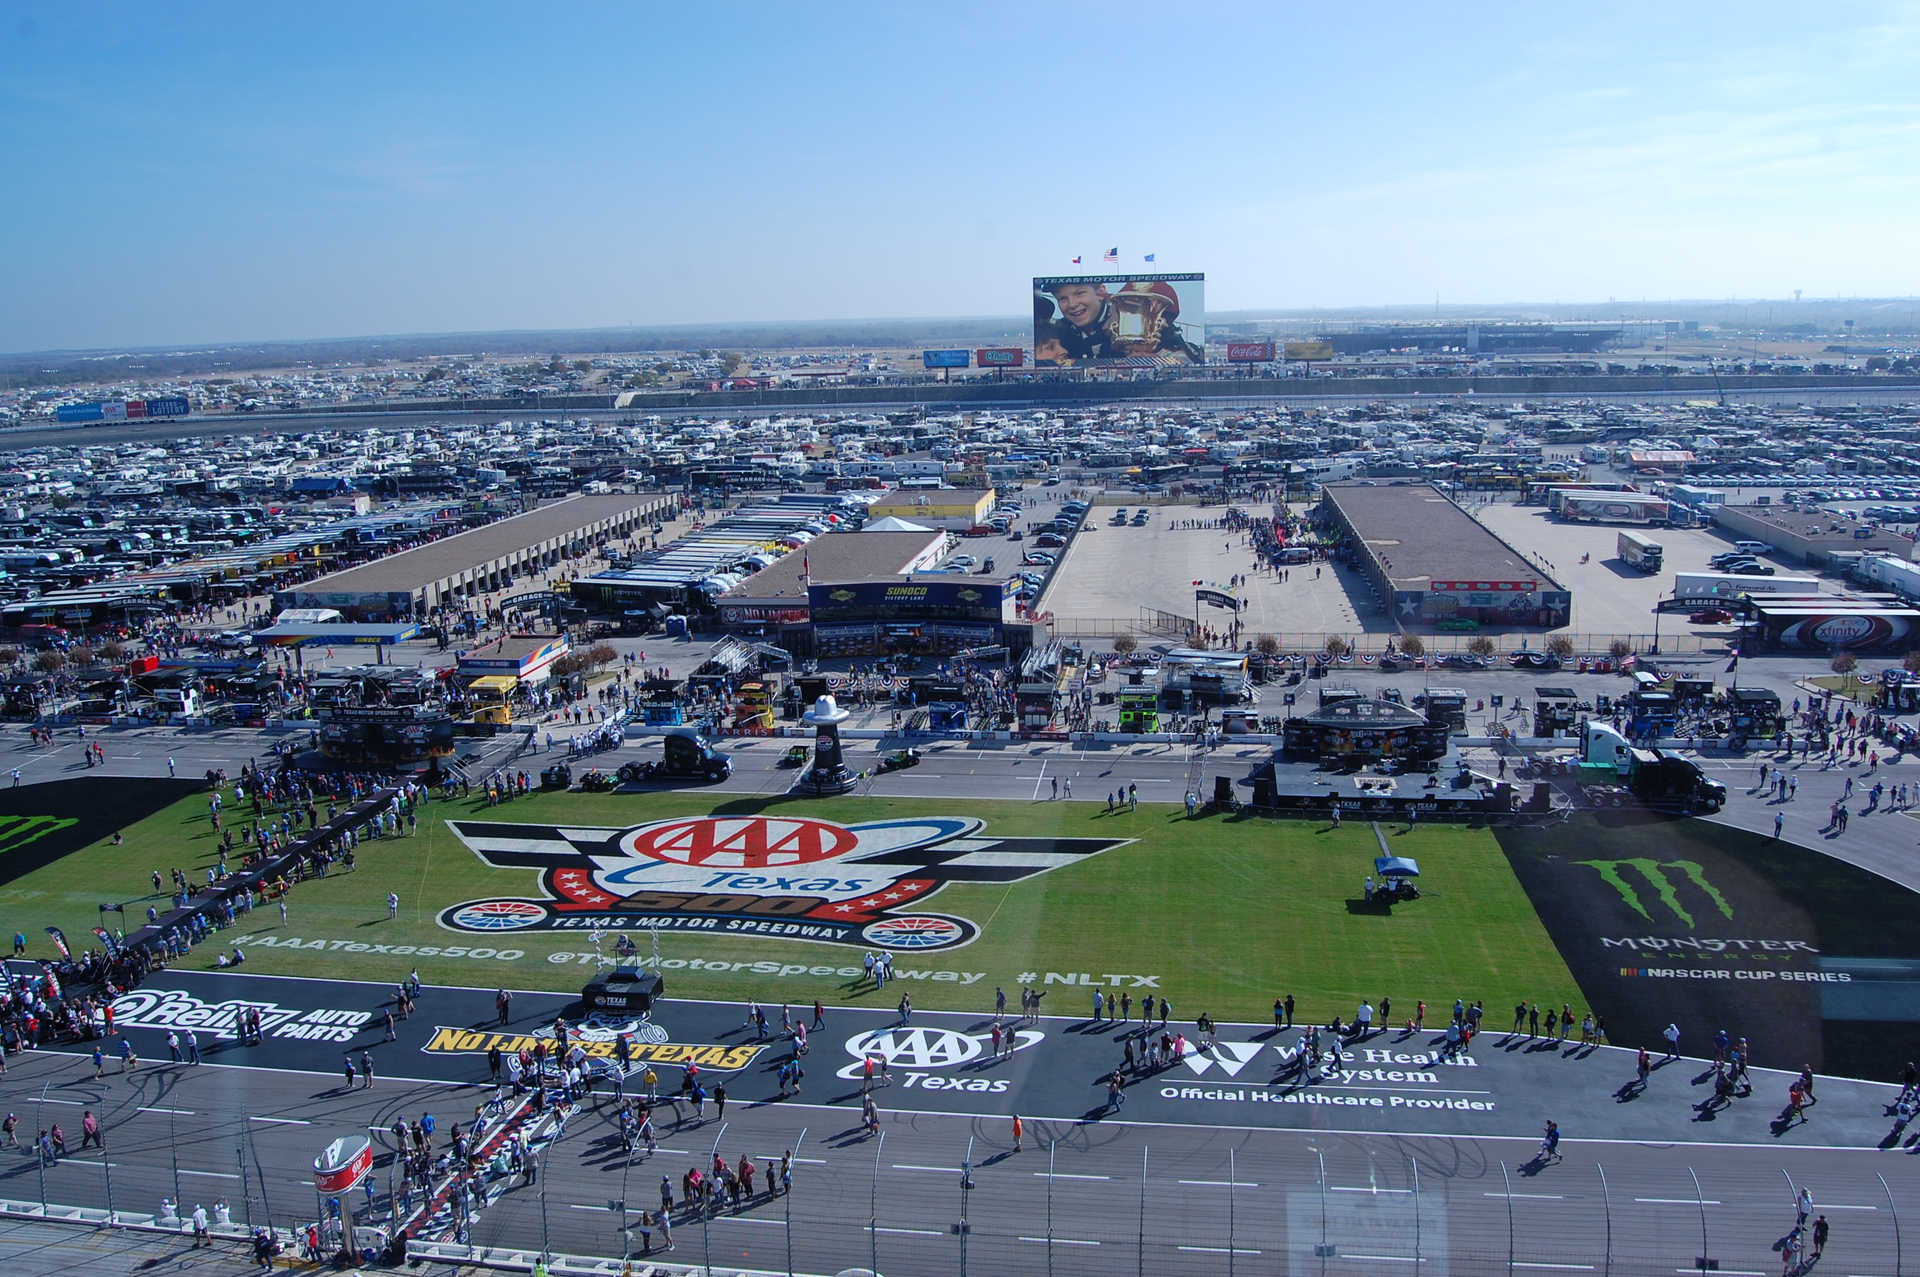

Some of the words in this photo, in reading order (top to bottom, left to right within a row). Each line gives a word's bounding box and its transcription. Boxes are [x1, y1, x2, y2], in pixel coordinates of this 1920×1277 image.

[1129, 274, 1193, 282] SPEEDWAY
[985, 351, 1015, 362] O'Reilly
[58, 407, 100, 415] PORTACOOL
[152, 405, 185, 415] LOTTERY
[512, 592, 543, 603] GARAGE
[886, 586, 928, 596] SUNOCO
[744, 607, 760, 620] NO
[1819, 625, 1861, 637] xfinity
[720, 727, 768, 737] ARRIS
[640, 817, 850, 869] AAA
[700, 871, 865, 893] Texas
[618, 891, 822, 914] 500
[551, 916, 628, 929] TEXAS
[635, 916, 718, 929] MOTOR
[726, 918, 855, 941] SPEEDWAY
[1600, 936, 1819, 953] MONSTER
[229, 934, 525, 962] #AAATexas500
[547, 951, 986, 985] @TxMotorSpeeway
[1016, 971, 1161, 989] #NLTX
[1641, 952, 1794, 961] ENERGY
[1647, 968, 1731, 979] NASCAR
[1734, 969, 1777, 981] CUP
[1780, 971, 1852, 982] SERIES
[299, 1009, 372, 1026] AUTO
[272, 1023, 359, 1043] PARTS
[432, 1029, 485, 1051] NO
[629, 1043, 760, 1068] TEXAS
[855, 1028, 973, 1066] AAA
[1273, 1046, 1355, 1062] Wse
[1363, 1048, 1478, 1067] Health
[902, 1072, 1011, 1093] Texas
[1320, 1065, 1439, 1085] System
[1160, 1087, 1245, 1101] Official
[1252, 1091, 1384, 1108] Healthcare
[1390, 1096, 1496, 1111] Provider
